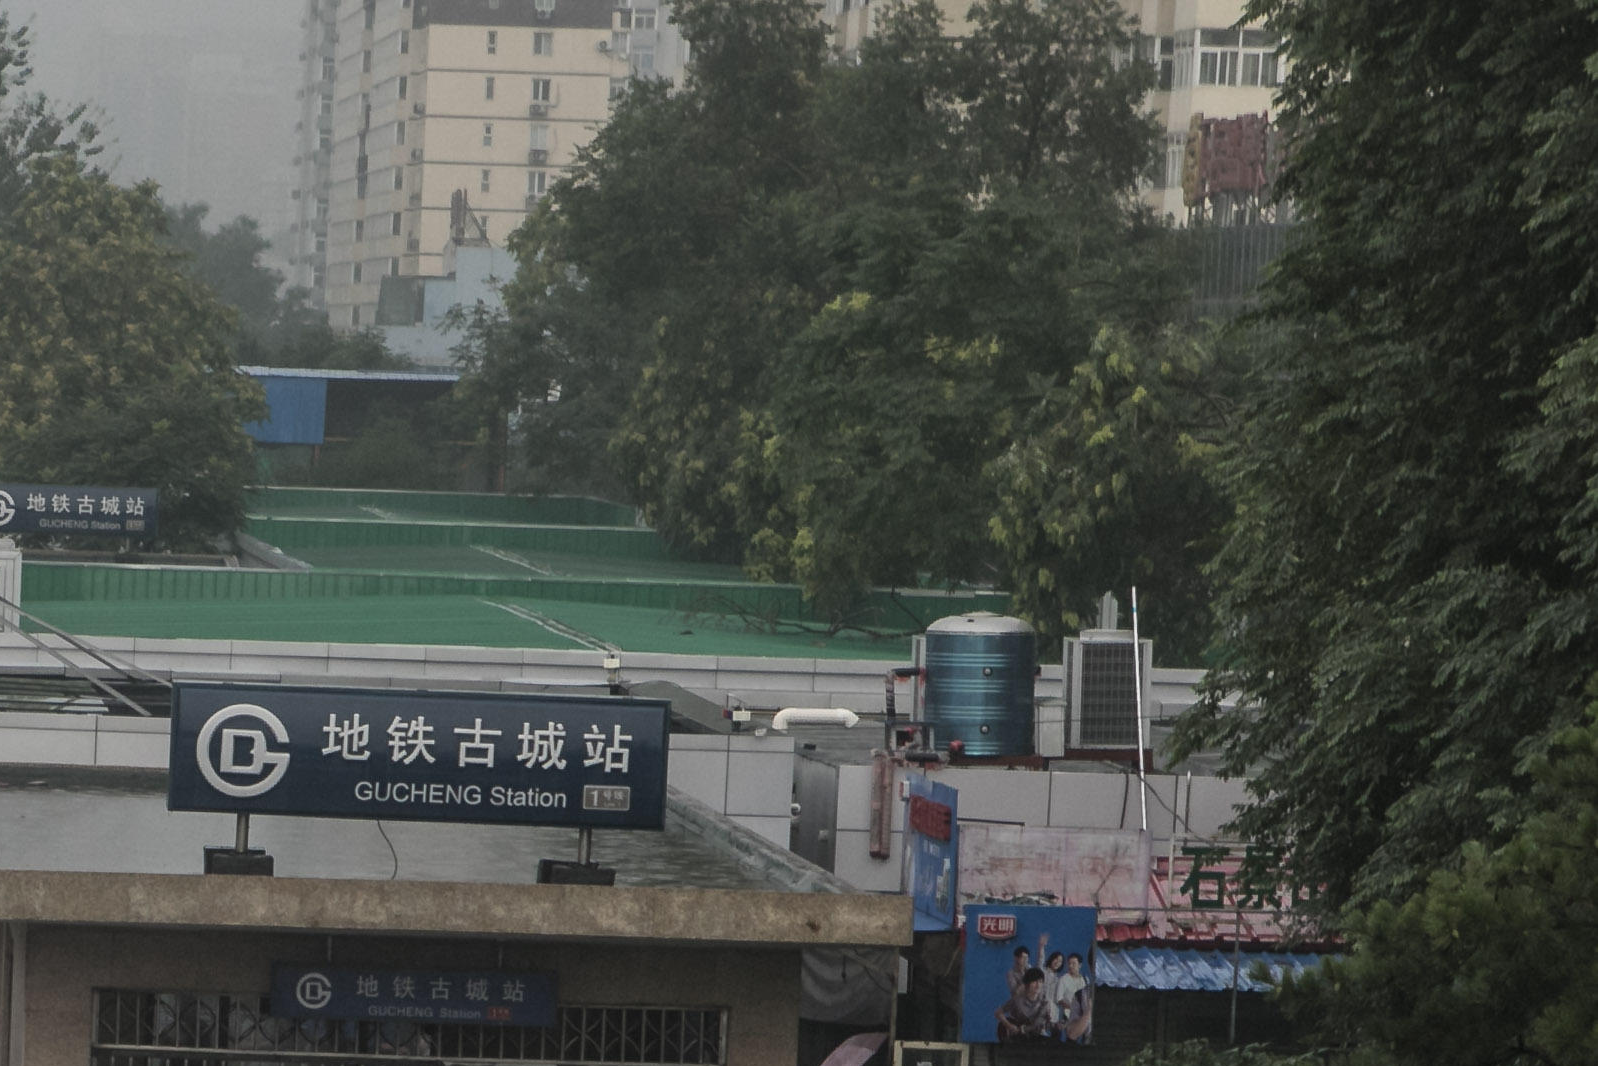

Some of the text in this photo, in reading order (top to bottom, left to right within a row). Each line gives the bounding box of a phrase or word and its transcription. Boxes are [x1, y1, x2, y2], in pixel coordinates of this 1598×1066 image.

[26, 492, 146, 517] 地铁古城站
[39, 518, 89, 530] GUCHENG
[321, 712, 634, 774] 地铁古城站
[353, 780, 568, 808] GUCHENG Station
[982, 917, 1015, 932] 光明
[356, 974, 527, 1004] 地铁古城站
[368, 1005, 434, 1018] GUCHENG
